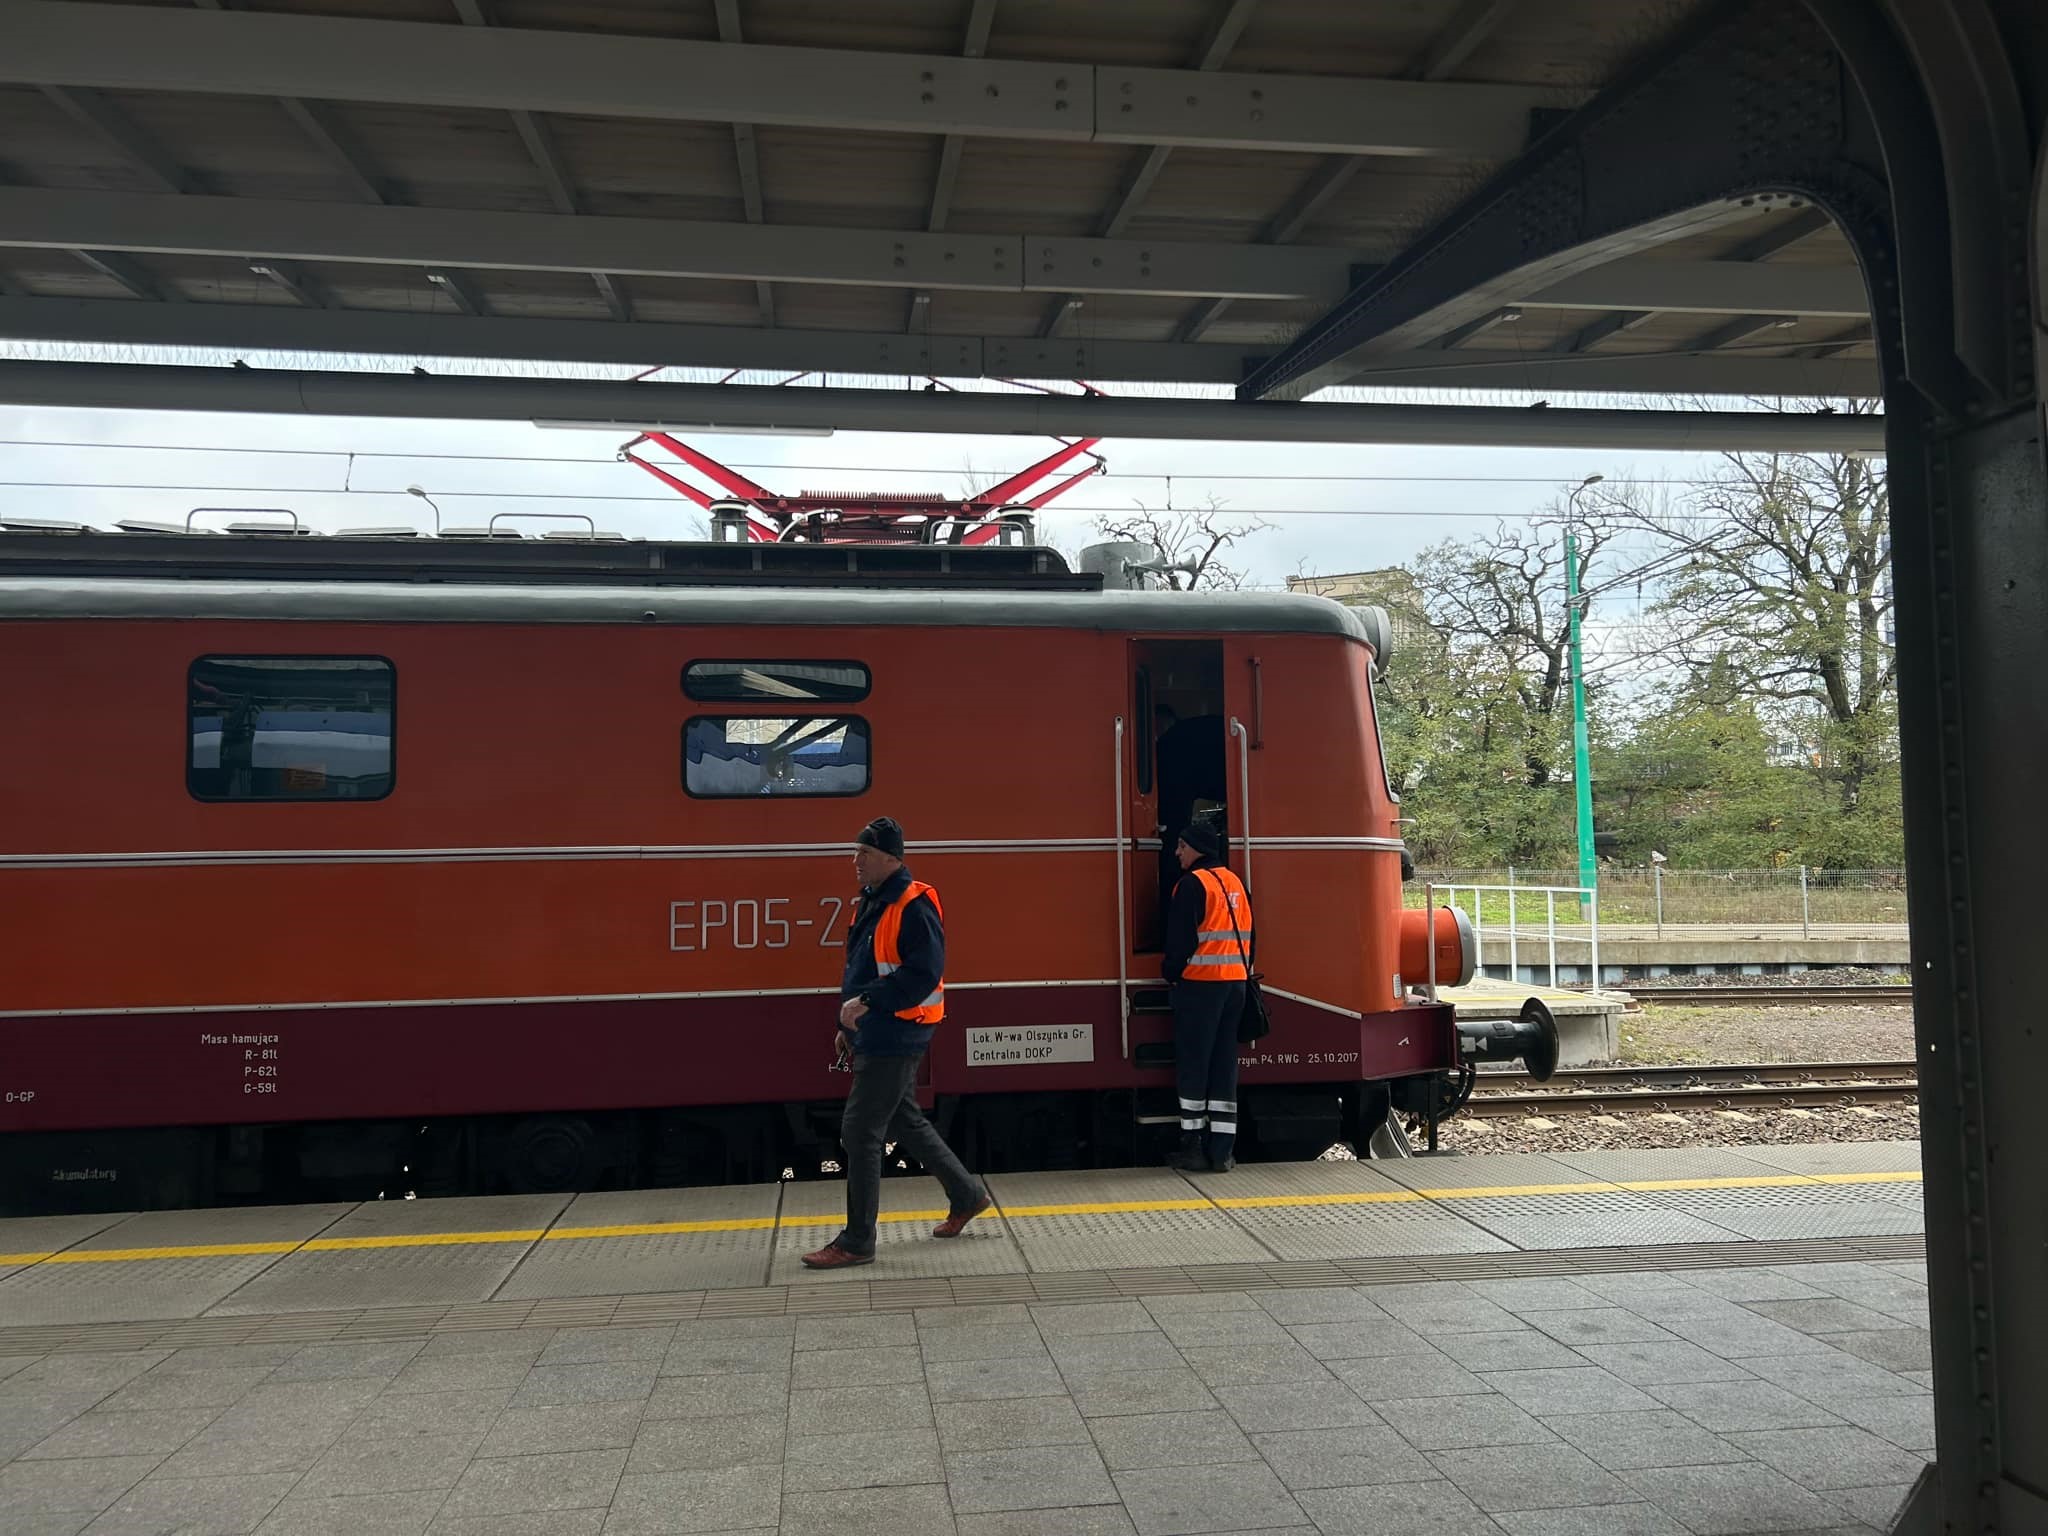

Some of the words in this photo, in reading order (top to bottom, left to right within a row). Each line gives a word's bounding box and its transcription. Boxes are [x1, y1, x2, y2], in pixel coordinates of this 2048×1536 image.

[201, 1033, 228, 1045] Masa
[232, 1033, 279, 1046] hamująca
[972, 1032, 992, 1044] Lok.
[994, 1031, 1022, 1042] W-wa
[1026, 1030, 1069, 1043] Olszynka
[1072, 1028, 1087, 1039] Gr.
[973, 1048, 1021, 1061] Centralna
[1025, 1047, 1053, 1059] DOKP
[1278, 1053, 1300, 1064] RWG
[1307, 1052, 1359, 1064] 25.10.2017
